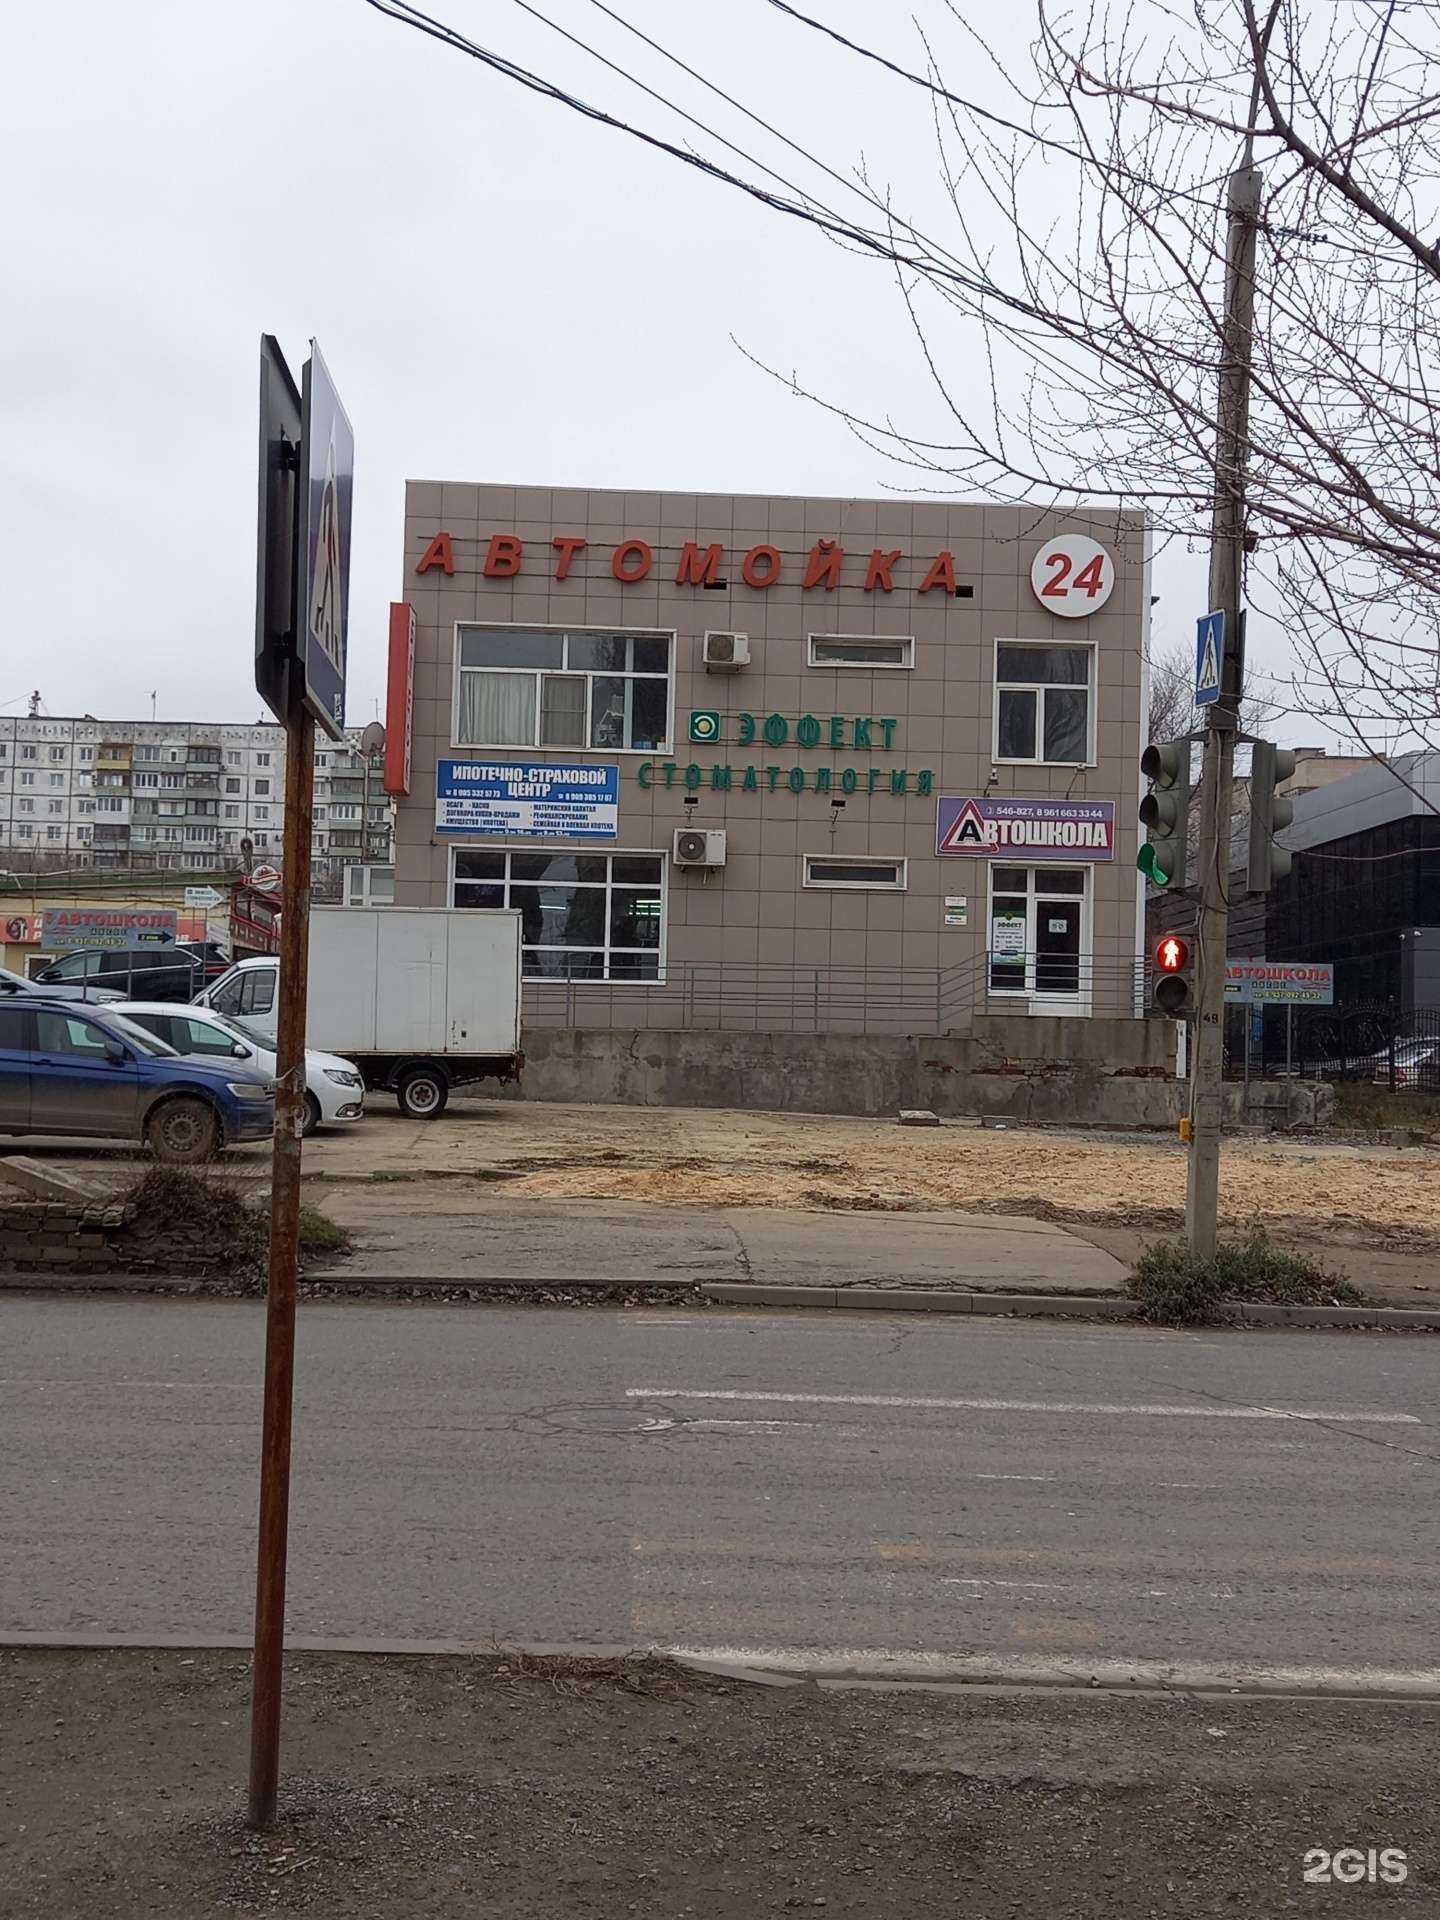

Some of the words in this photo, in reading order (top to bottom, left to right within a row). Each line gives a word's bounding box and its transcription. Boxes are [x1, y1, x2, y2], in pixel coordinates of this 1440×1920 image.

[415, 532, 956, 594] АВТОМОЙКА
[1041, 552, 1105, 597] 24
[738, 713, 897, 749] ЭФФЕКТ
[452, 765, 607, 785] ИПОТЕЧНО-СТРАХОВОЙ
[638, 762, 934, 796] СТОМАТОЛОГИЯ
[508, 782, 551, 798] ЦЕНТР
[57, 912, 176, 928] АВТОШКОЛА
